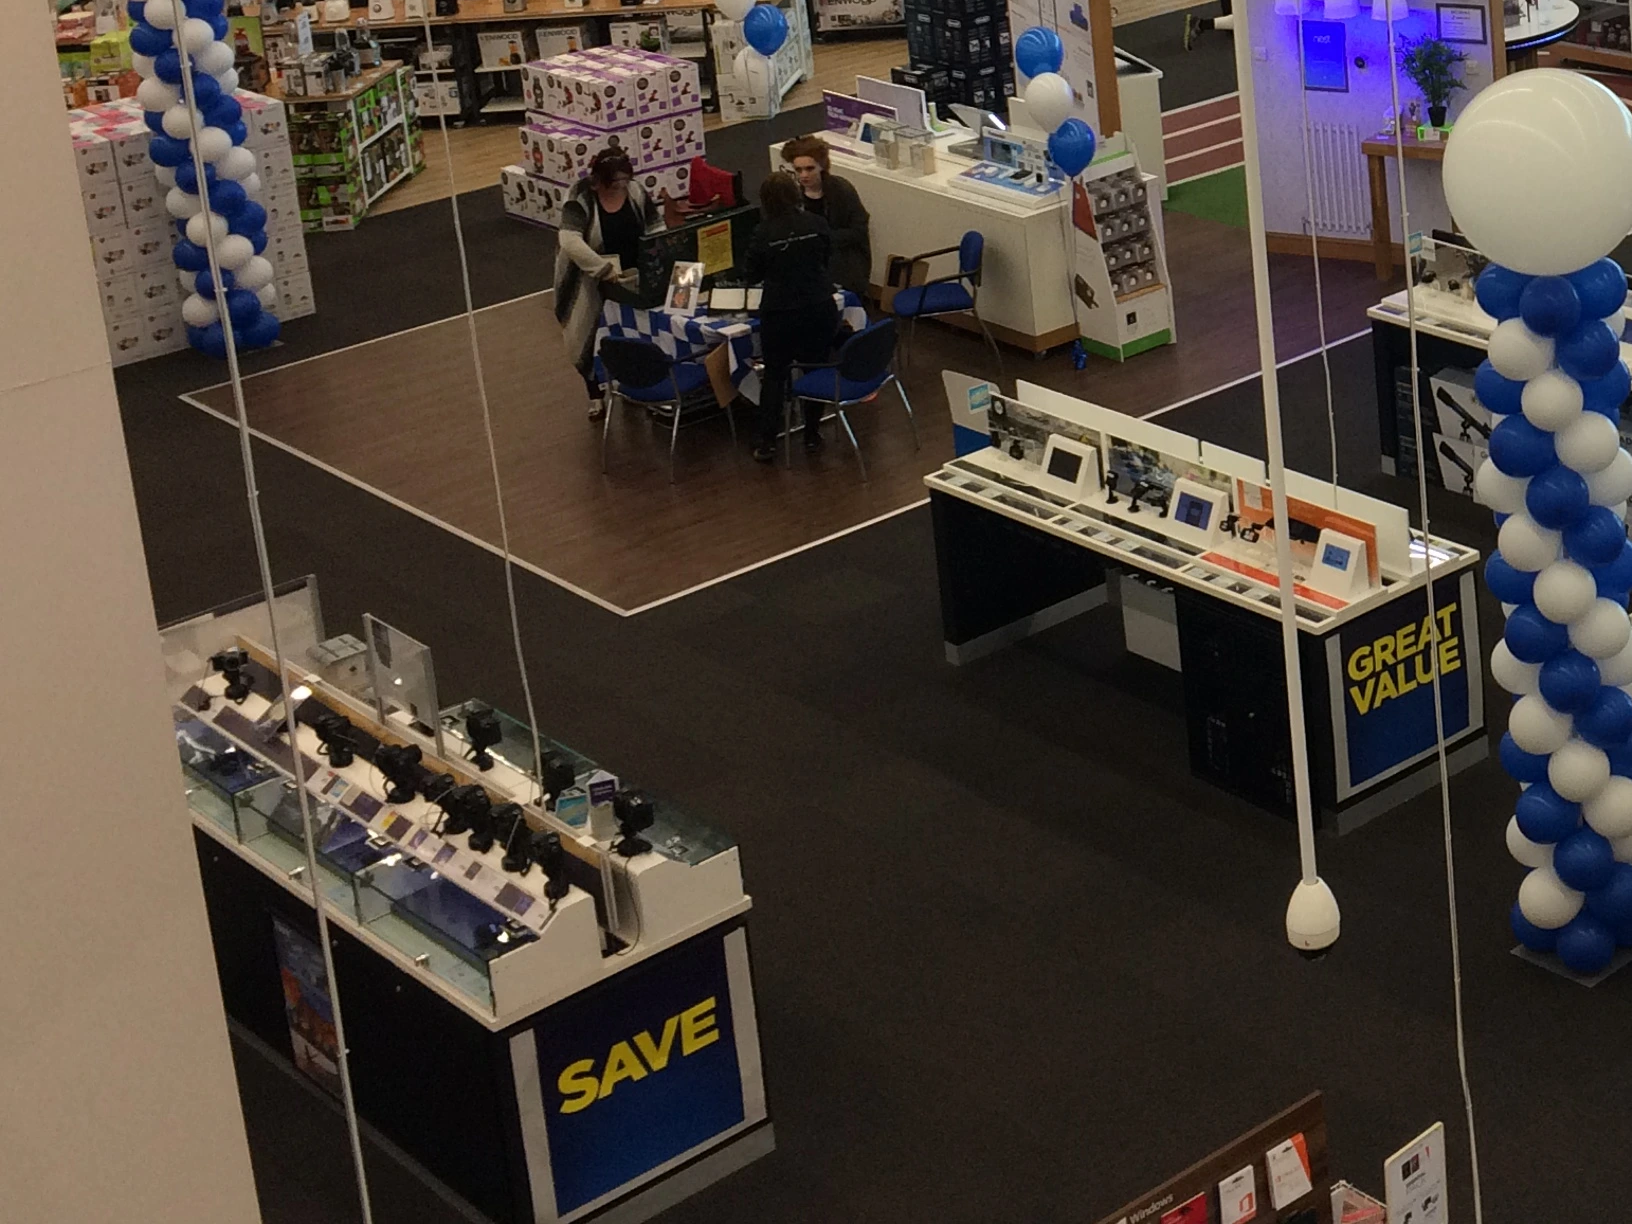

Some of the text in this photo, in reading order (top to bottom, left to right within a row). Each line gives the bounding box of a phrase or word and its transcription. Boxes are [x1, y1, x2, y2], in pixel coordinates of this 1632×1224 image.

[1312, 34, 1331, 45] nest
[1347, 602, 1457, 681] GREAT
[1349, 636, 1461, 716] VALUE
[557, 995, 720, 1114] SAVE
[1129, 1193, 1175, 1224] Windows
